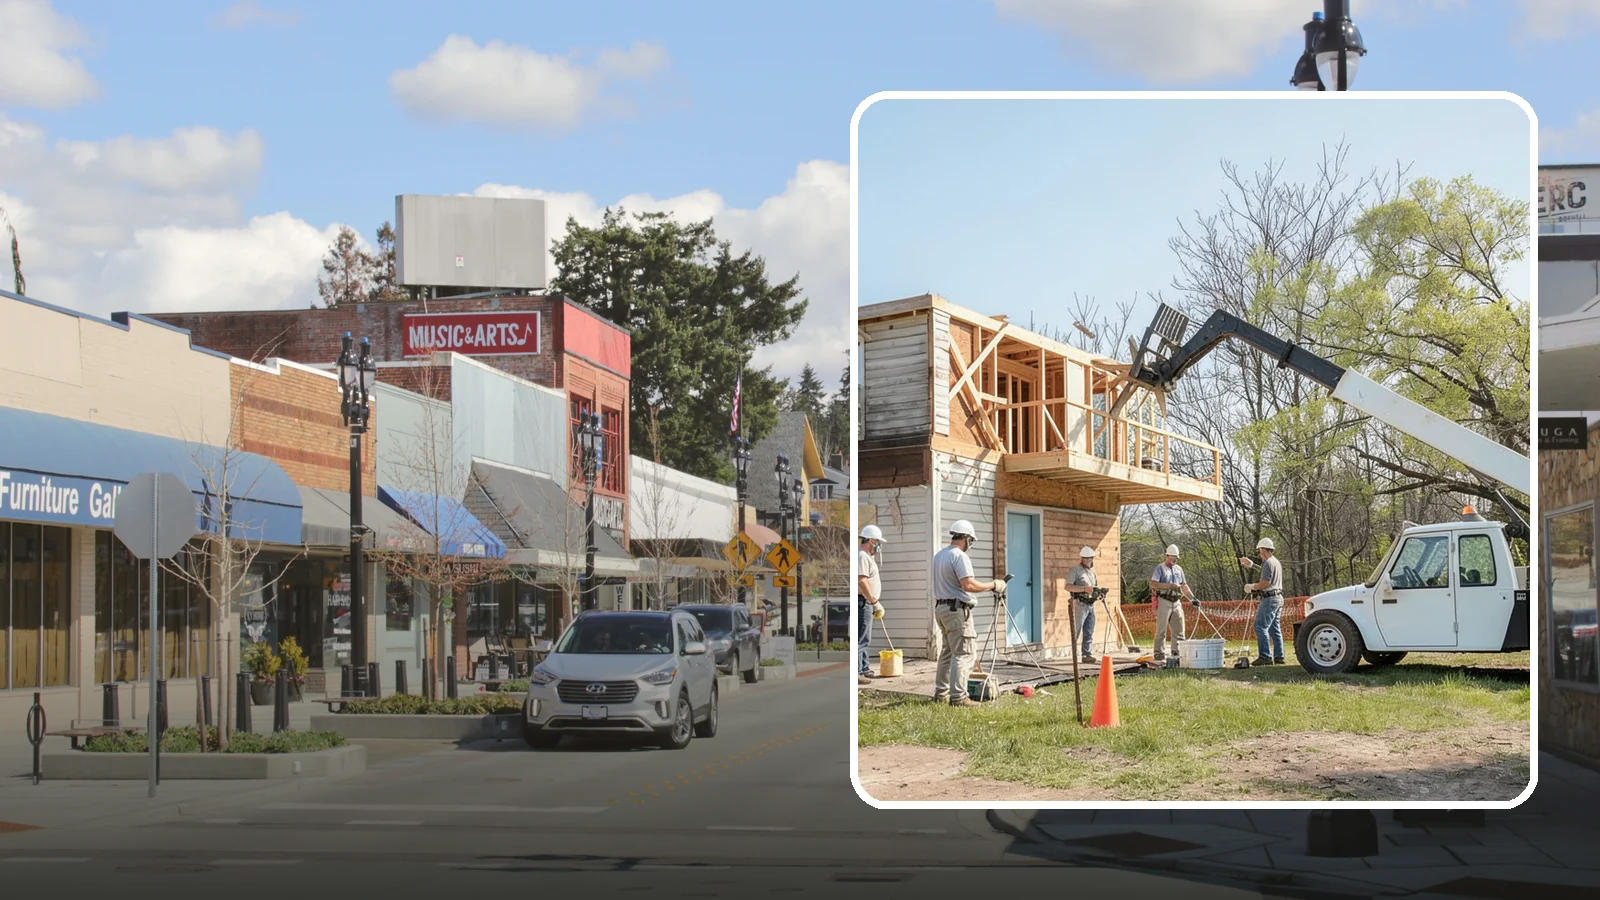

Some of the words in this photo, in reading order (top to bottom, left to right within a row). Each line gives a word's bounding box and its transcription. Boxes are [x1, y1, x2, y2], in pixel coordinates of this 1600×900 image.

[409, 322, 520, 349] MUSIC&ARTS
[1540, 427, 1578, 437] UGA
[0, 471, 80, 516] Furniture
[89, 482, 122, 519] Gal
[453, 563, 480, 574] SUSHI
